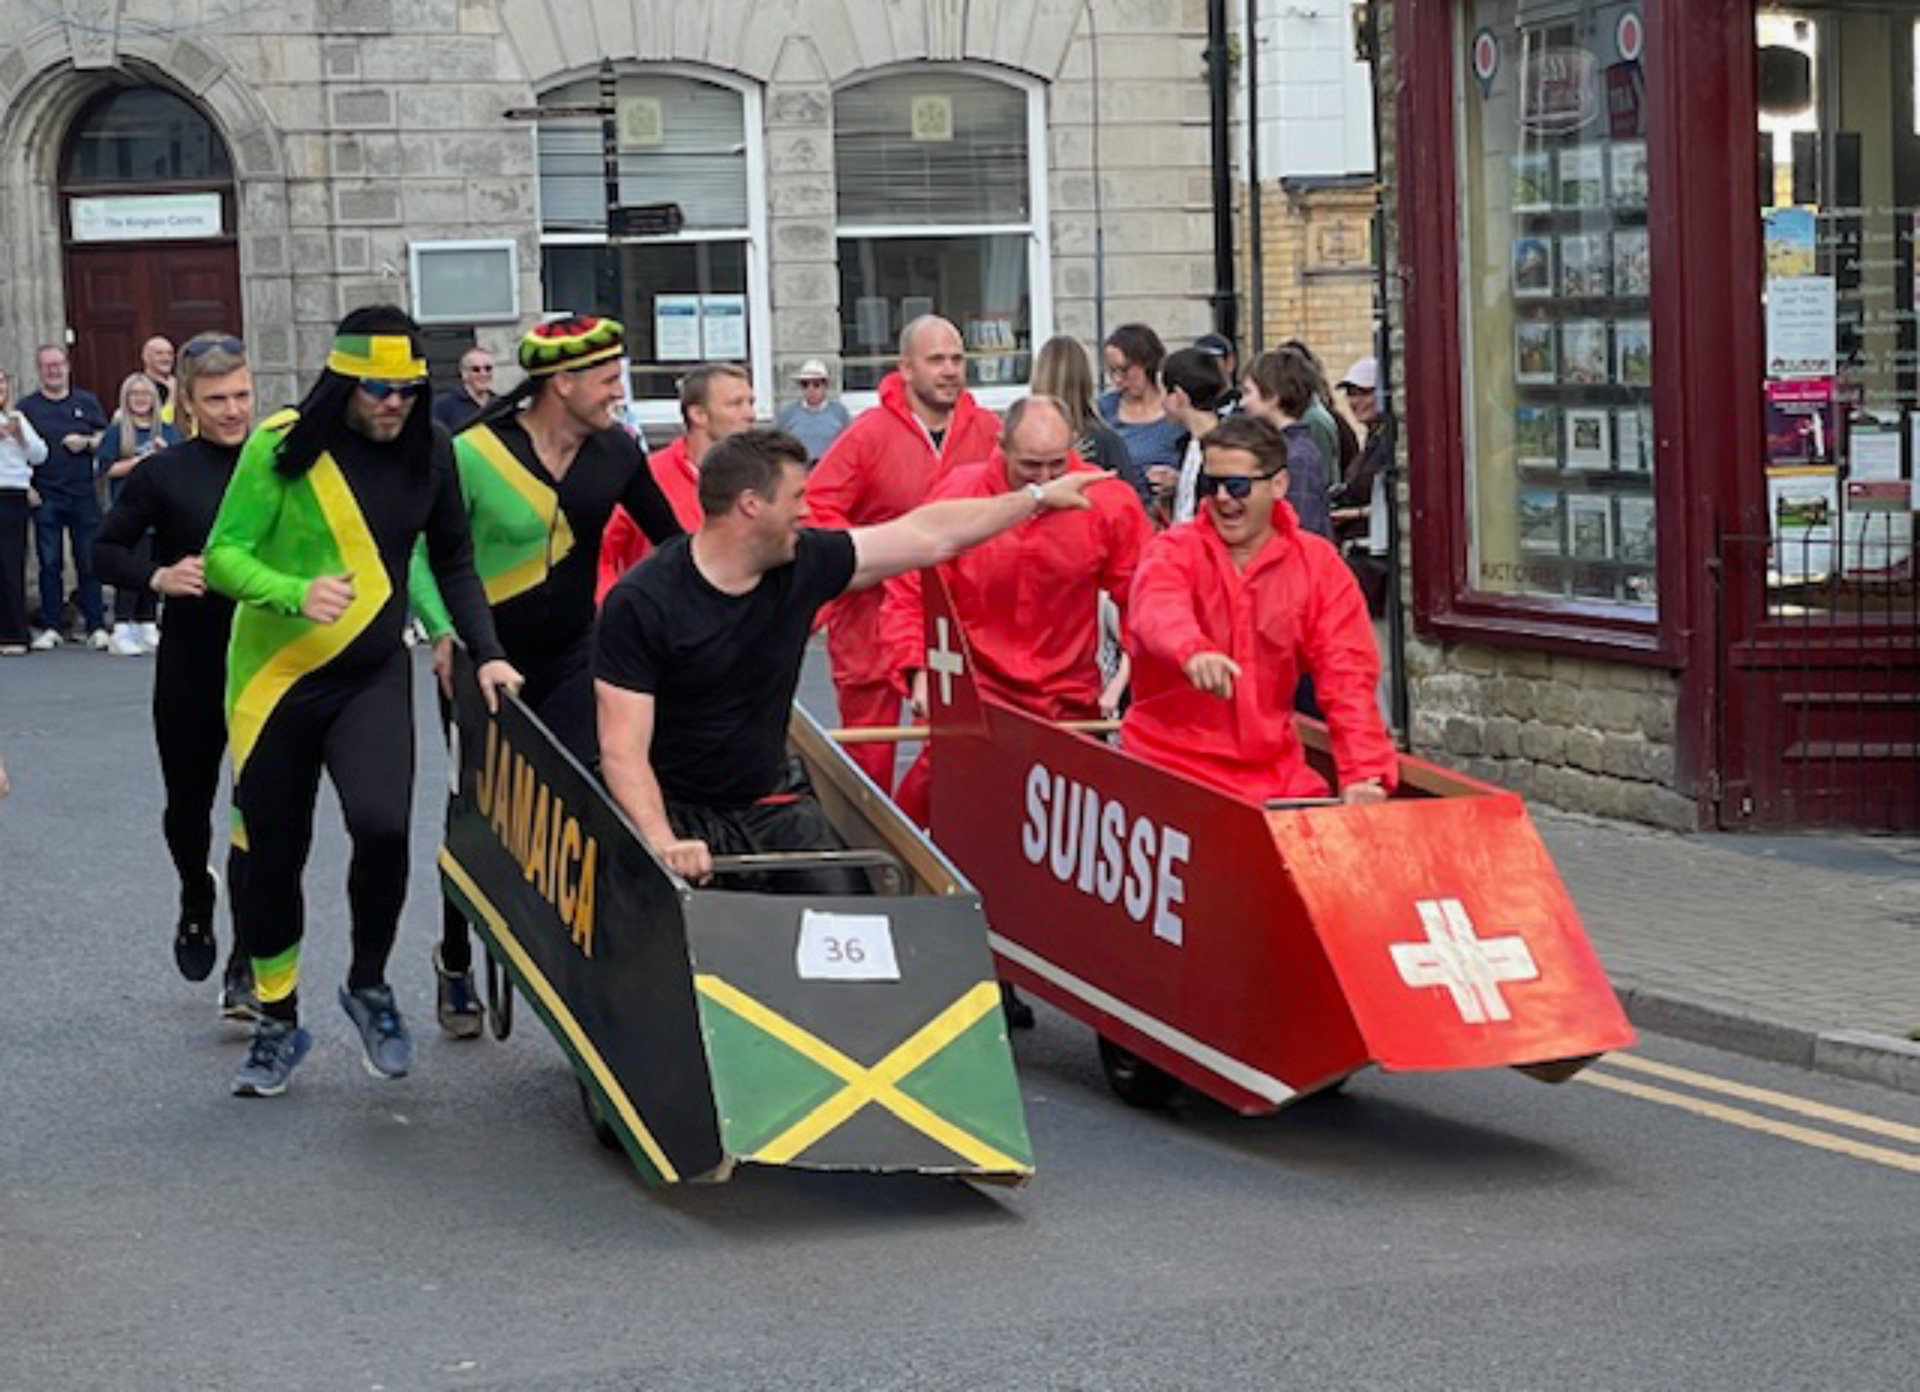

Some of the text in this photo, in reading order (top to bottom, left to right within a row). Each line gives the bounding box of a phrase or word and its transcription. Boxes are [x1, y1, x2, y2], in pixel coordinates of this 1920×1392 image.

[476, 718, 597, 958] JAMAICA
[1022, 763, 1190, 946] SUISSE
[823, 936, 865, 963] 36
